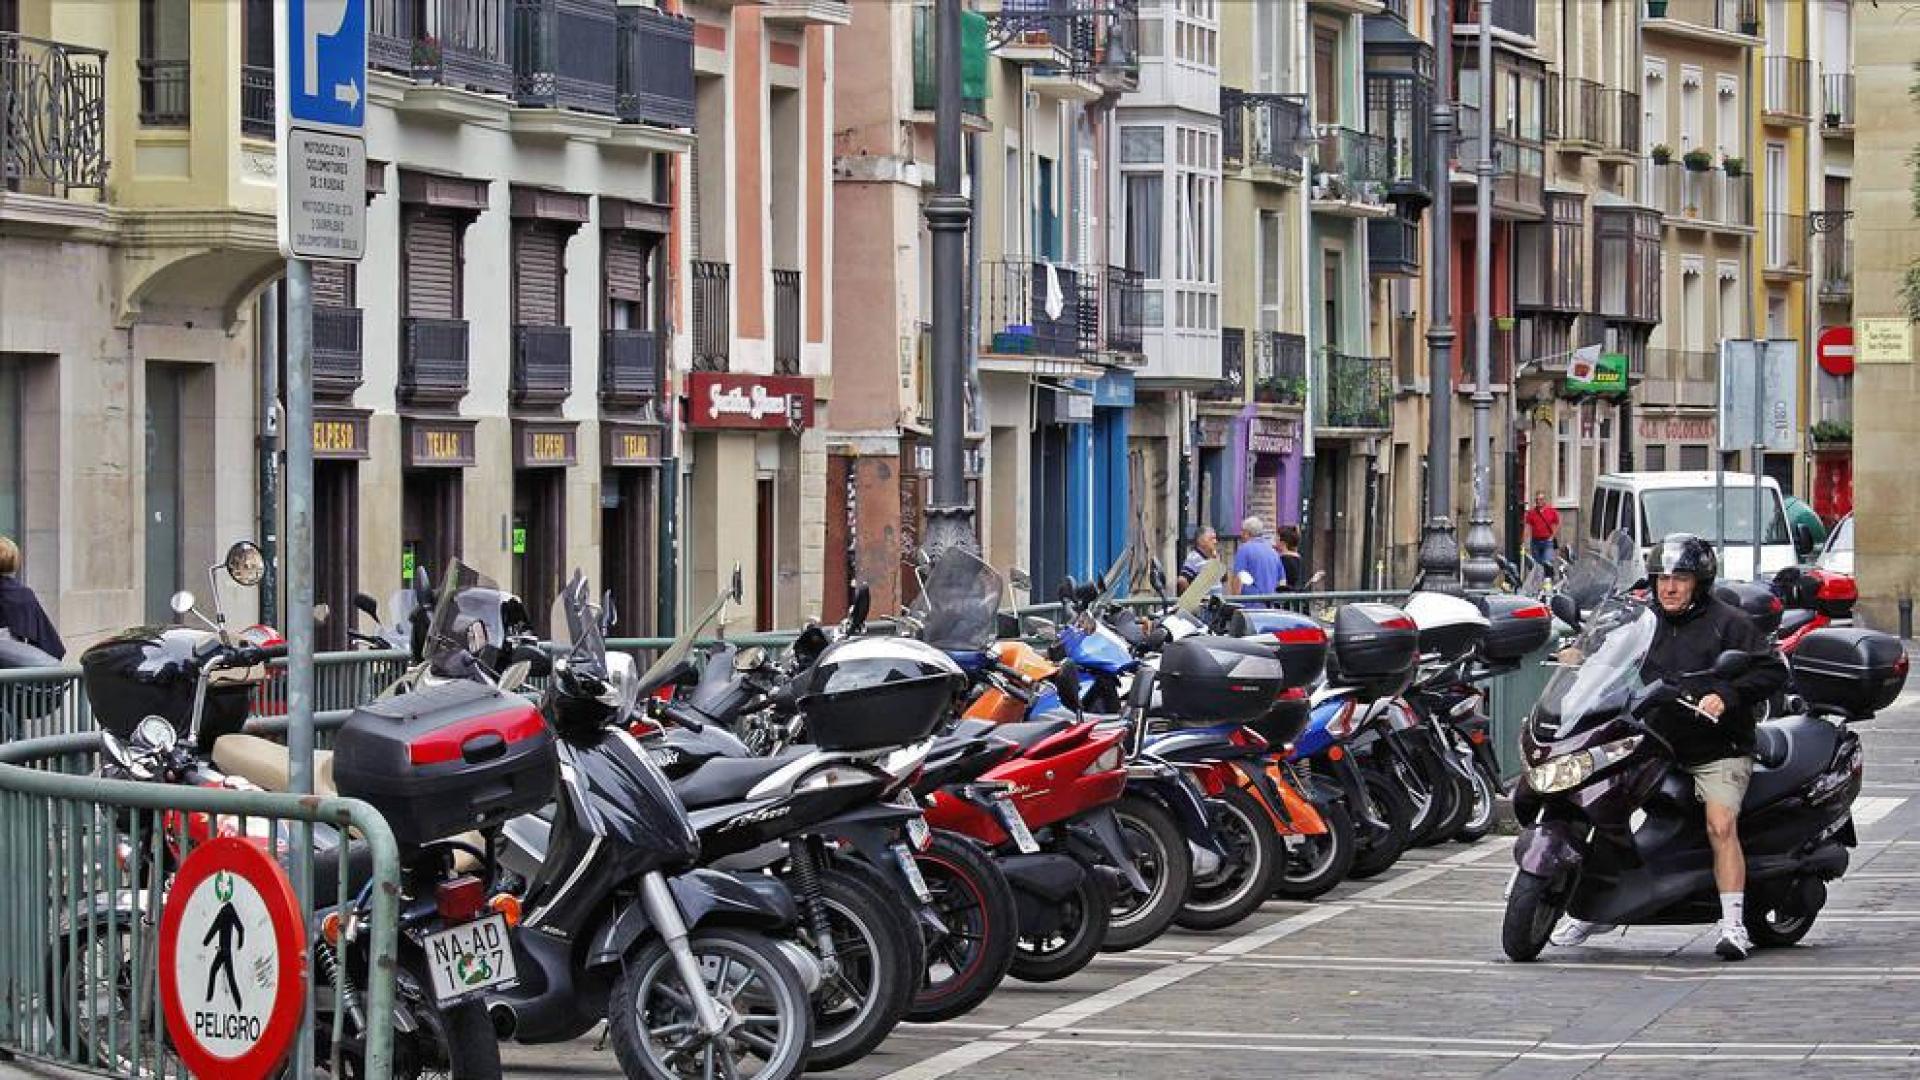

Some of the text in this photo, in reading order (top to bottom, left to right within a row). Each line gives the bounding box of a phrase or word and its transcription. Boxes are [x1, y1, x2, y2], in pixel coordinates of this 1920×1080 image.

[425, 432, 459, 457] TELAS
[623, 435, 648, 459] TELAS
[194, 1011, 261, 1042] PELIGRO
